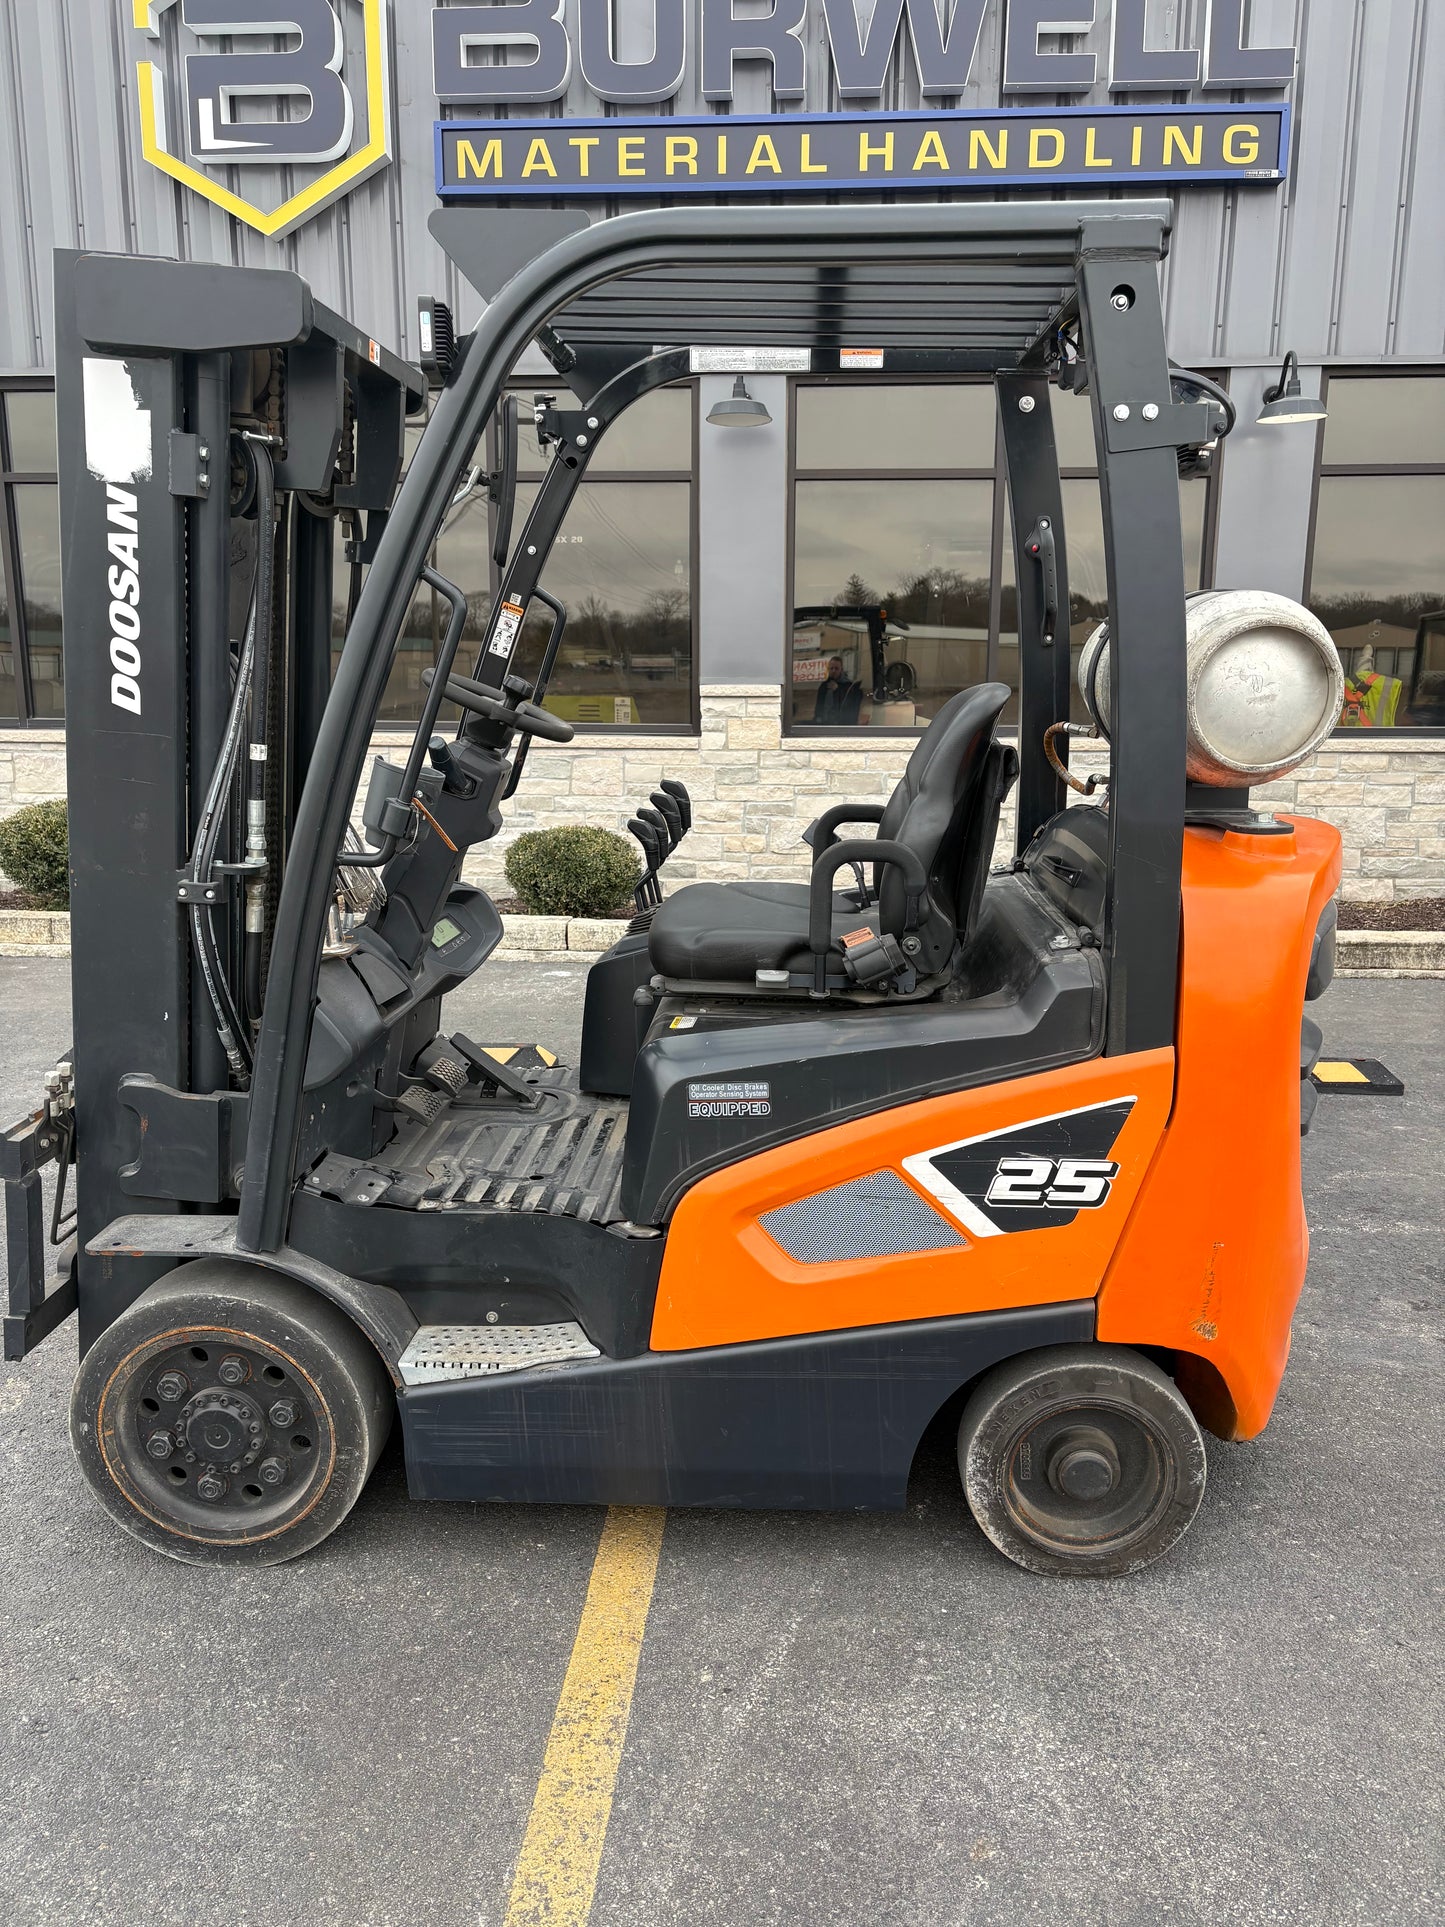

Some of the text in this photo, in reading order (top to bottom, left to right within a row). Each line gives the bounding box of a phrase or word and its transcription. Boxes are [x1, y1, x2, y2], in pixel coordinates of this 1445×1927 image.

[456, 124, 1260, 179] MATERIAL HANDLING
[105, 482, 142, 716] DOOSAN
[690, 1090, 768, 1099] Operator Sensing System
[744, 1083, 768, 1091] Brakes
[688, 1101, 771, 1117] EQUIPPED
[984, 1157, 1122, 1209] 25
